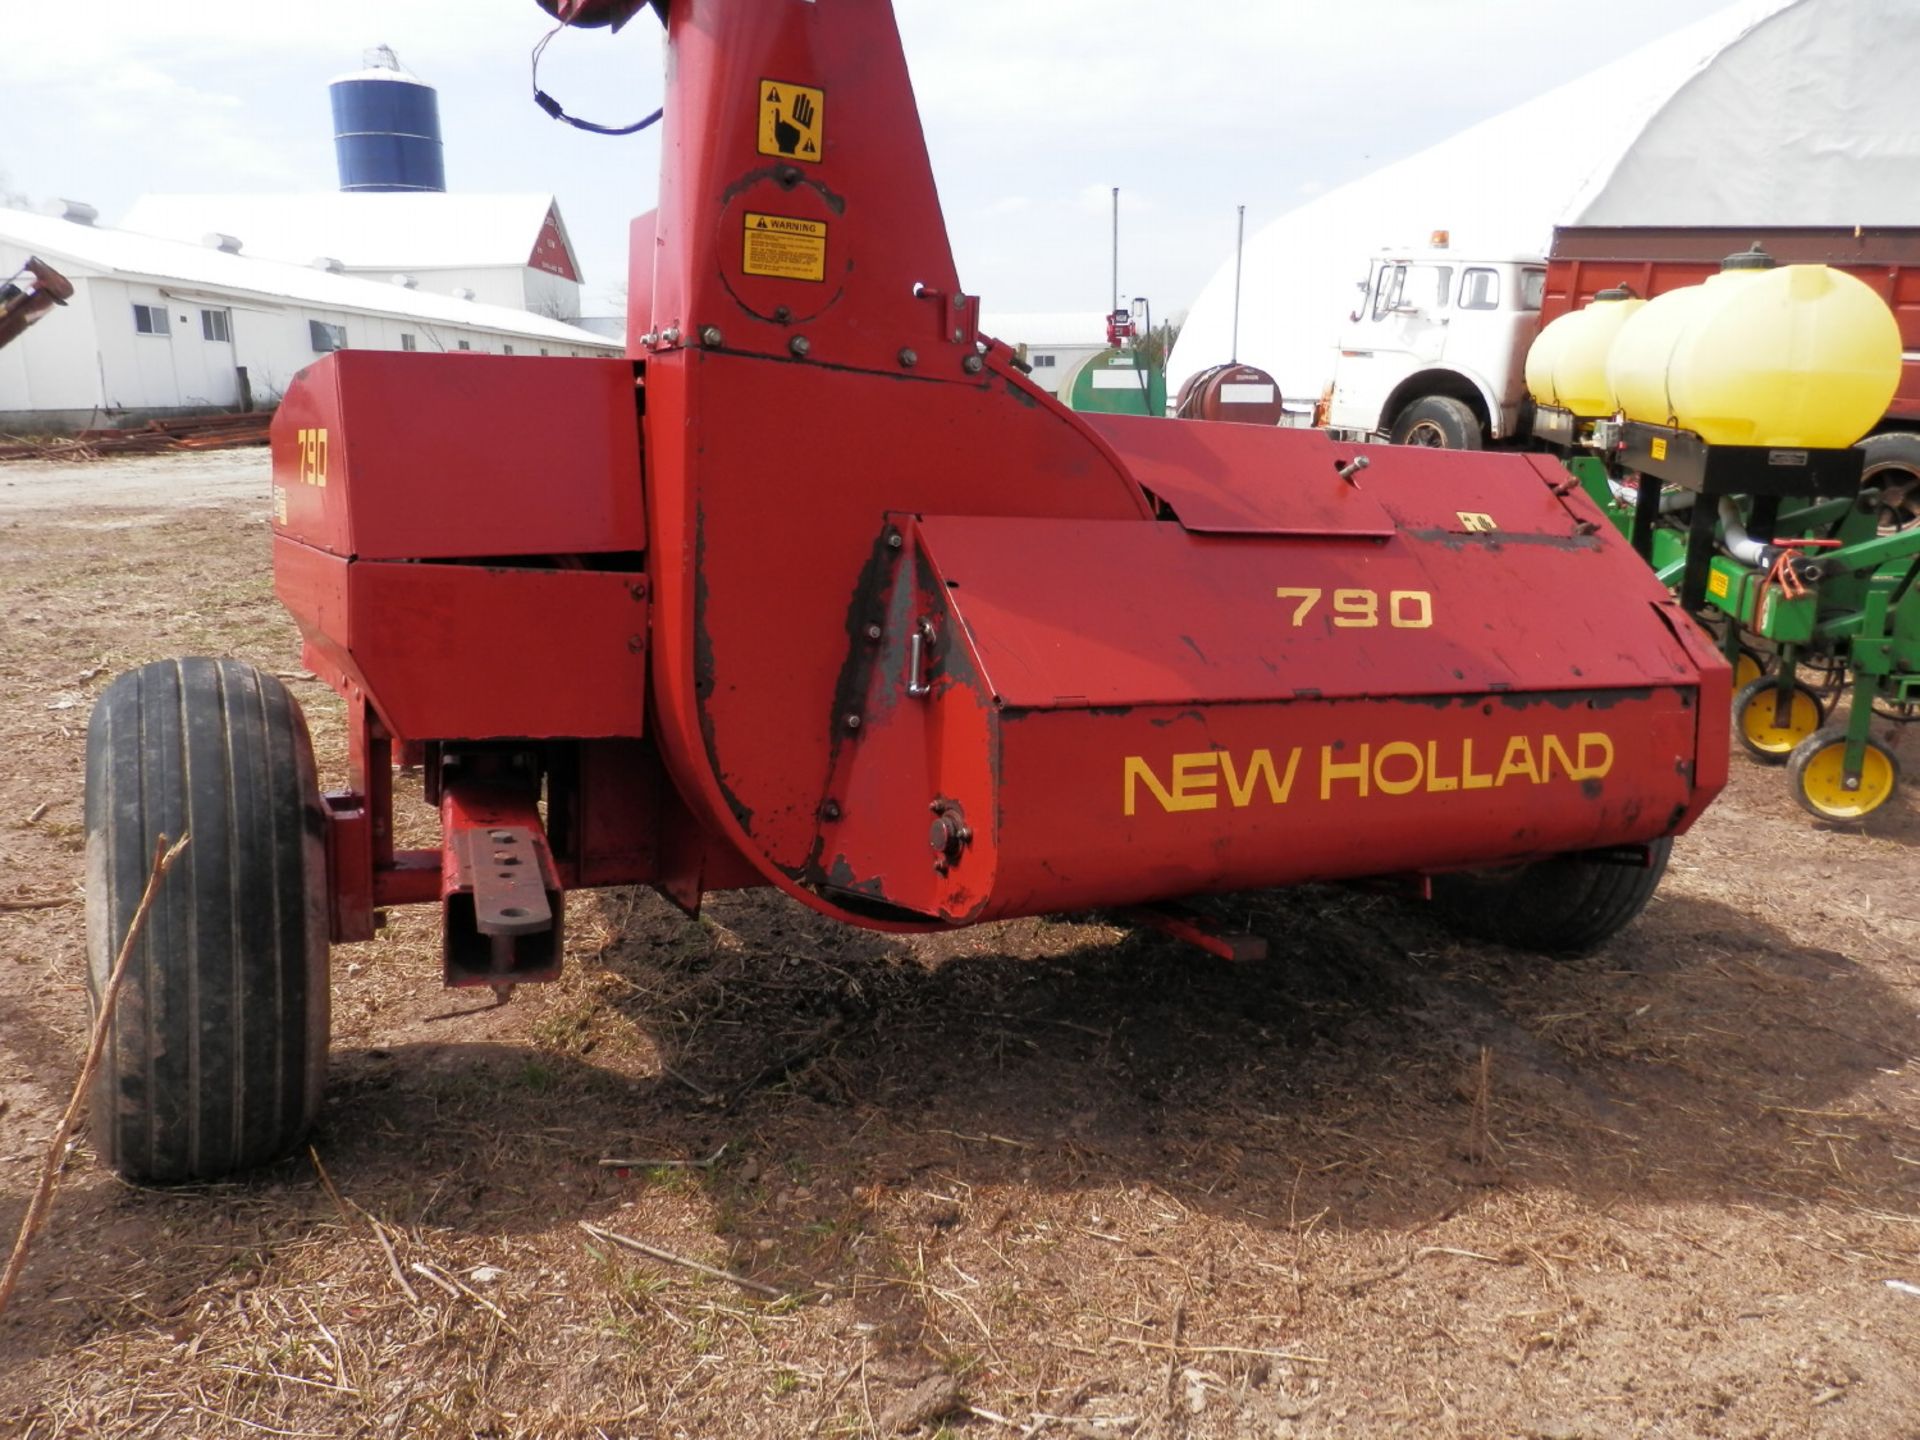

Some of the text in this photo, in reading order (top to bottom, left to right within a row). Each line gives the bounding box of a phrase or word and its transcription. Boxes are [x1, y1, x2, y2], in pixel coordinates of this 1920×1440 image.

[770, 219, 816, 232] WARNING
[298, 428, 328, 487] 790
[1276, 587, 1433, 628] 790
[1124, 732, 1614, 816] NEW HOLLAND
